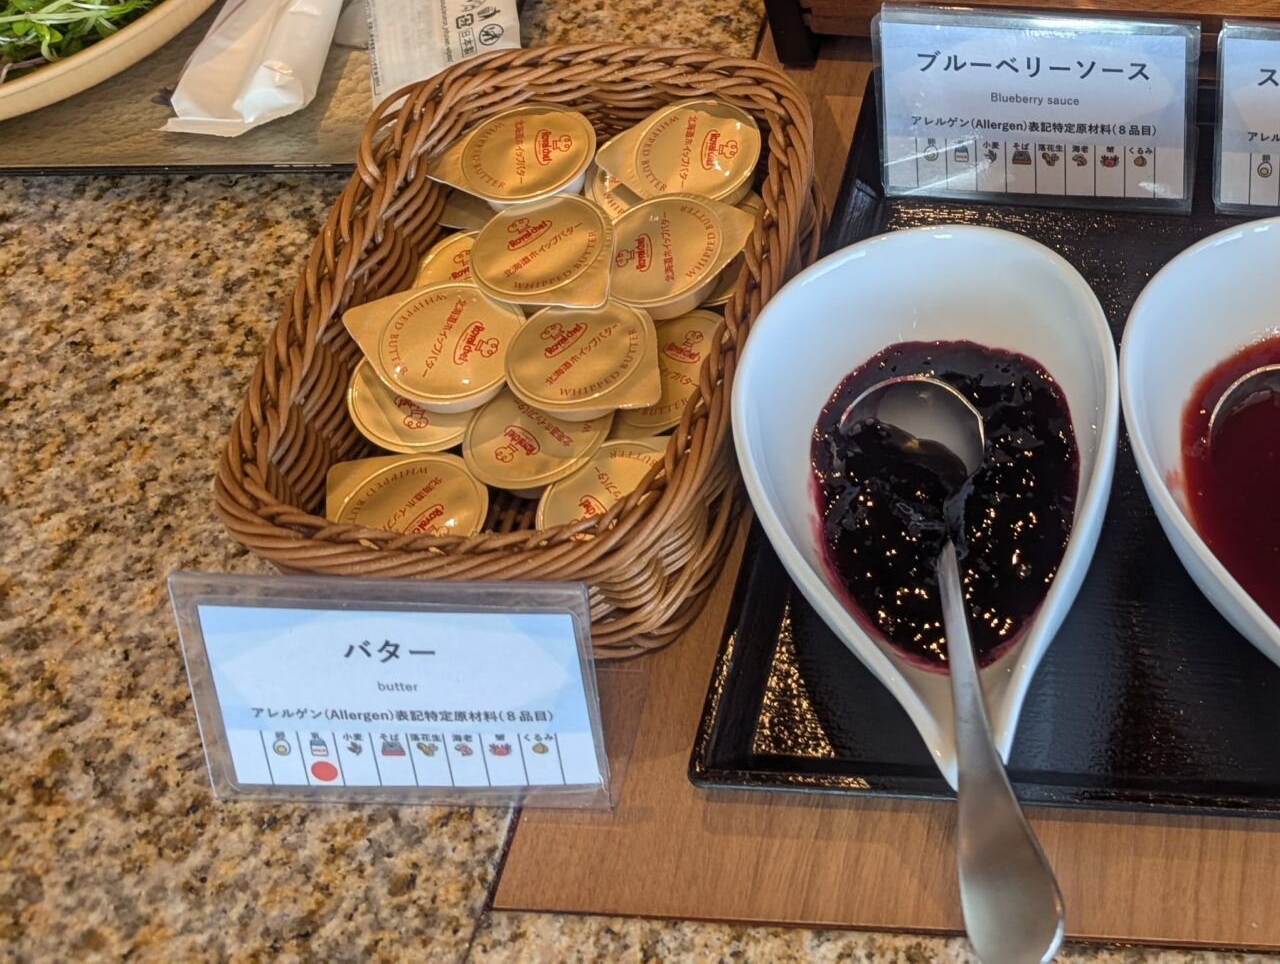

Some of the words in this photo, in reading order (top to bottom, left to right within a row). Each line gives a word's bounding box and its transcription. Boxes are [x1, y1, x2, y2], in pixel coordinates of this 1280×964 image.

[917, 50, 1150, 81] ブルーベリーソース
[991, 92, 1043, 106] Blueberry
[1047, 96, 1079, 106] sauce
[344, 639, 437, 663] バター
[377, 681, 418, 693] butter
